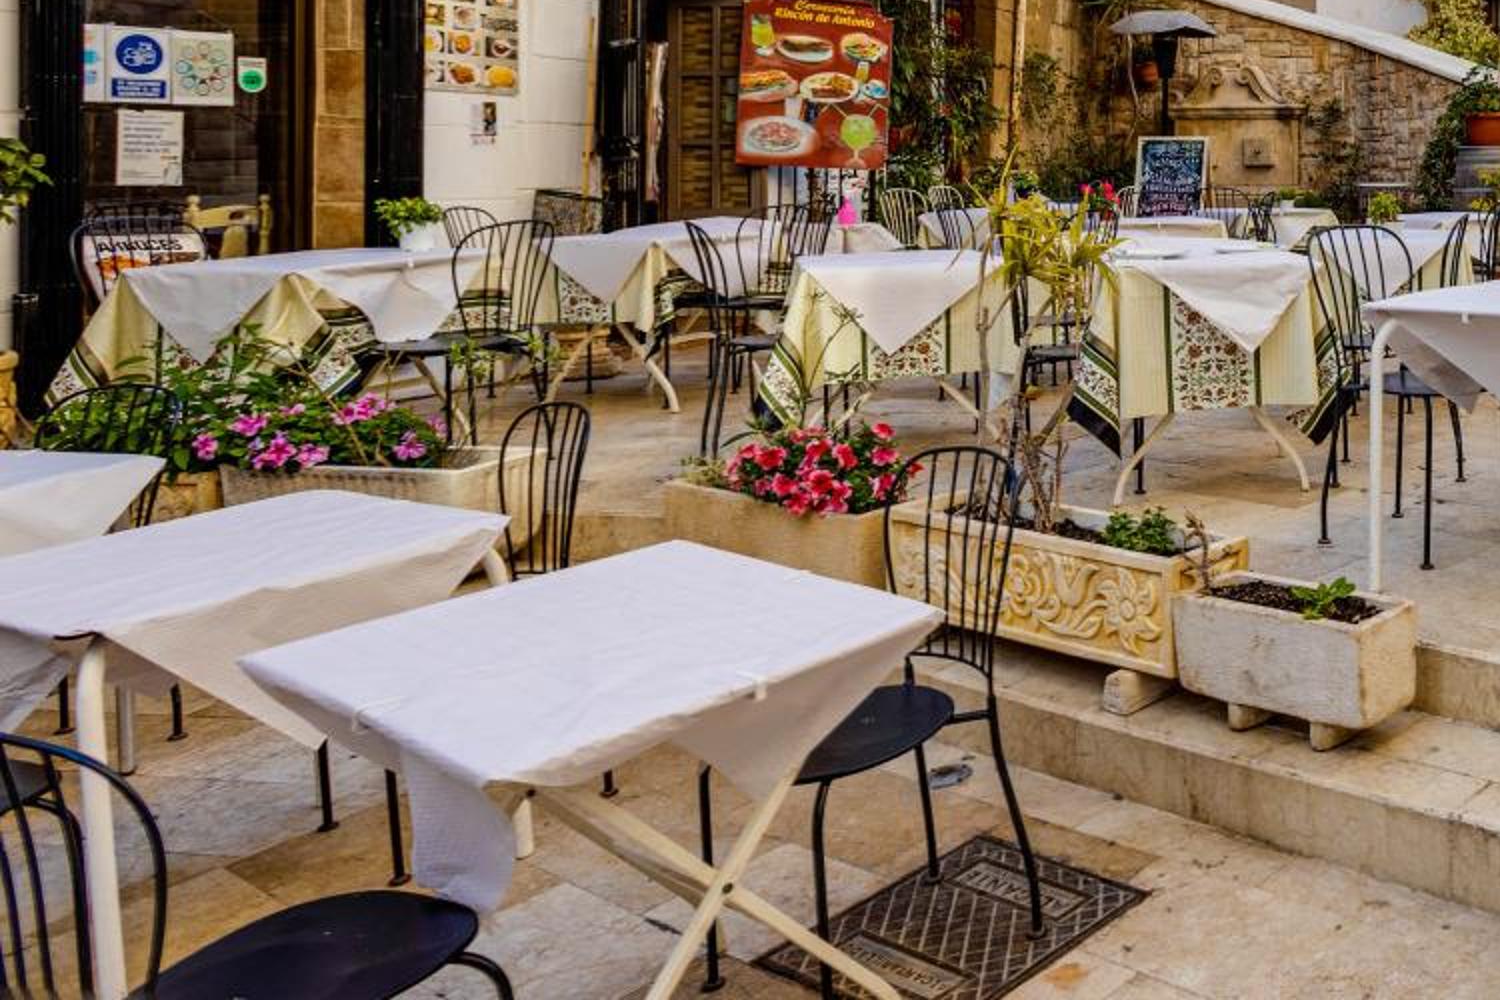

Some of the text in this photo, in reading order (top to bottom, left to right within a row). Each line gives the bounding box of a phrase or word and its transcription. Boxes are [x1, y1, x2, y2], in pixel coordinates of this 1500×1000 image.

[480, 13, 518, 33] Tapas
[775, 7, 875, 29] Rincón de Antonio
